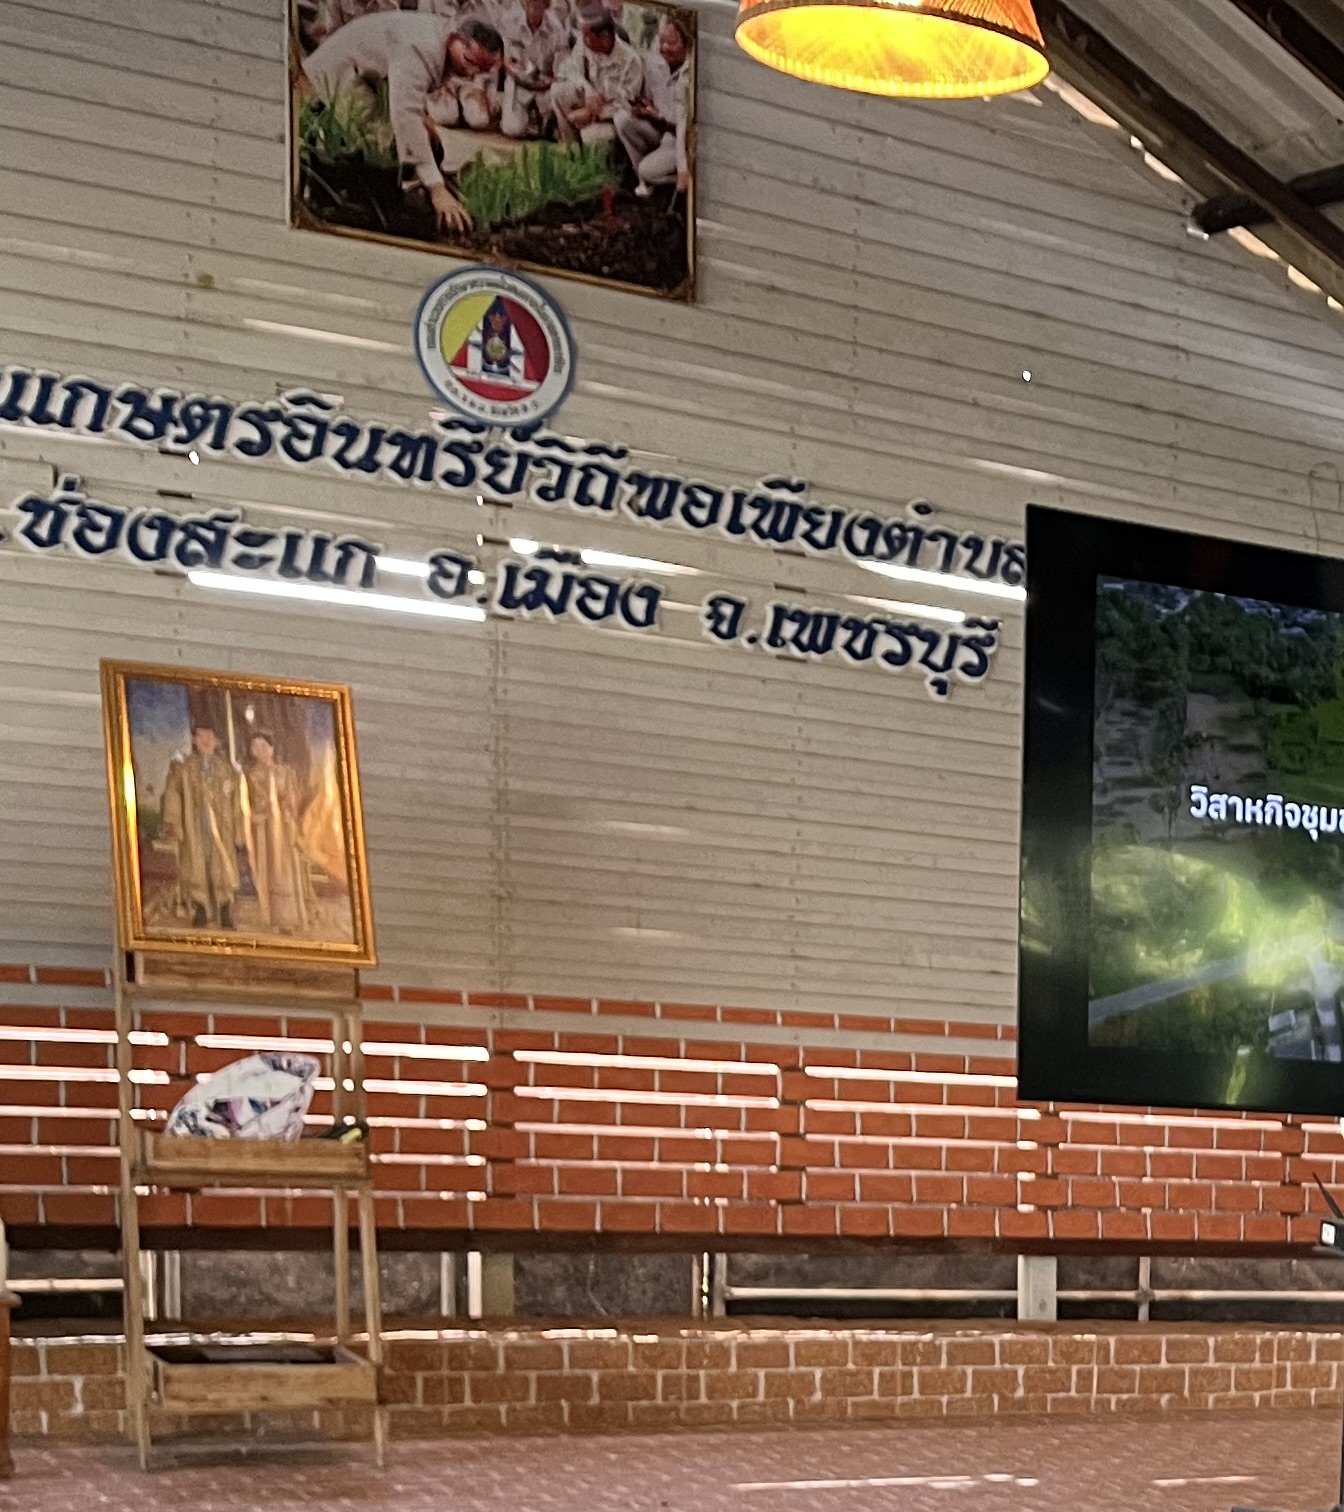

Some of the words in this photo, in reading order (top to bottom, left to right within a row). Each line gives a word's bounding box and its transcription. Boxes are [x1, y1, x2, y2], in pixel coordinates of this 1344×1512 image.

[428, 550, 661, 628] อ.เมือง
[706, 596, 999, 696] จ.เพชรบุรี
